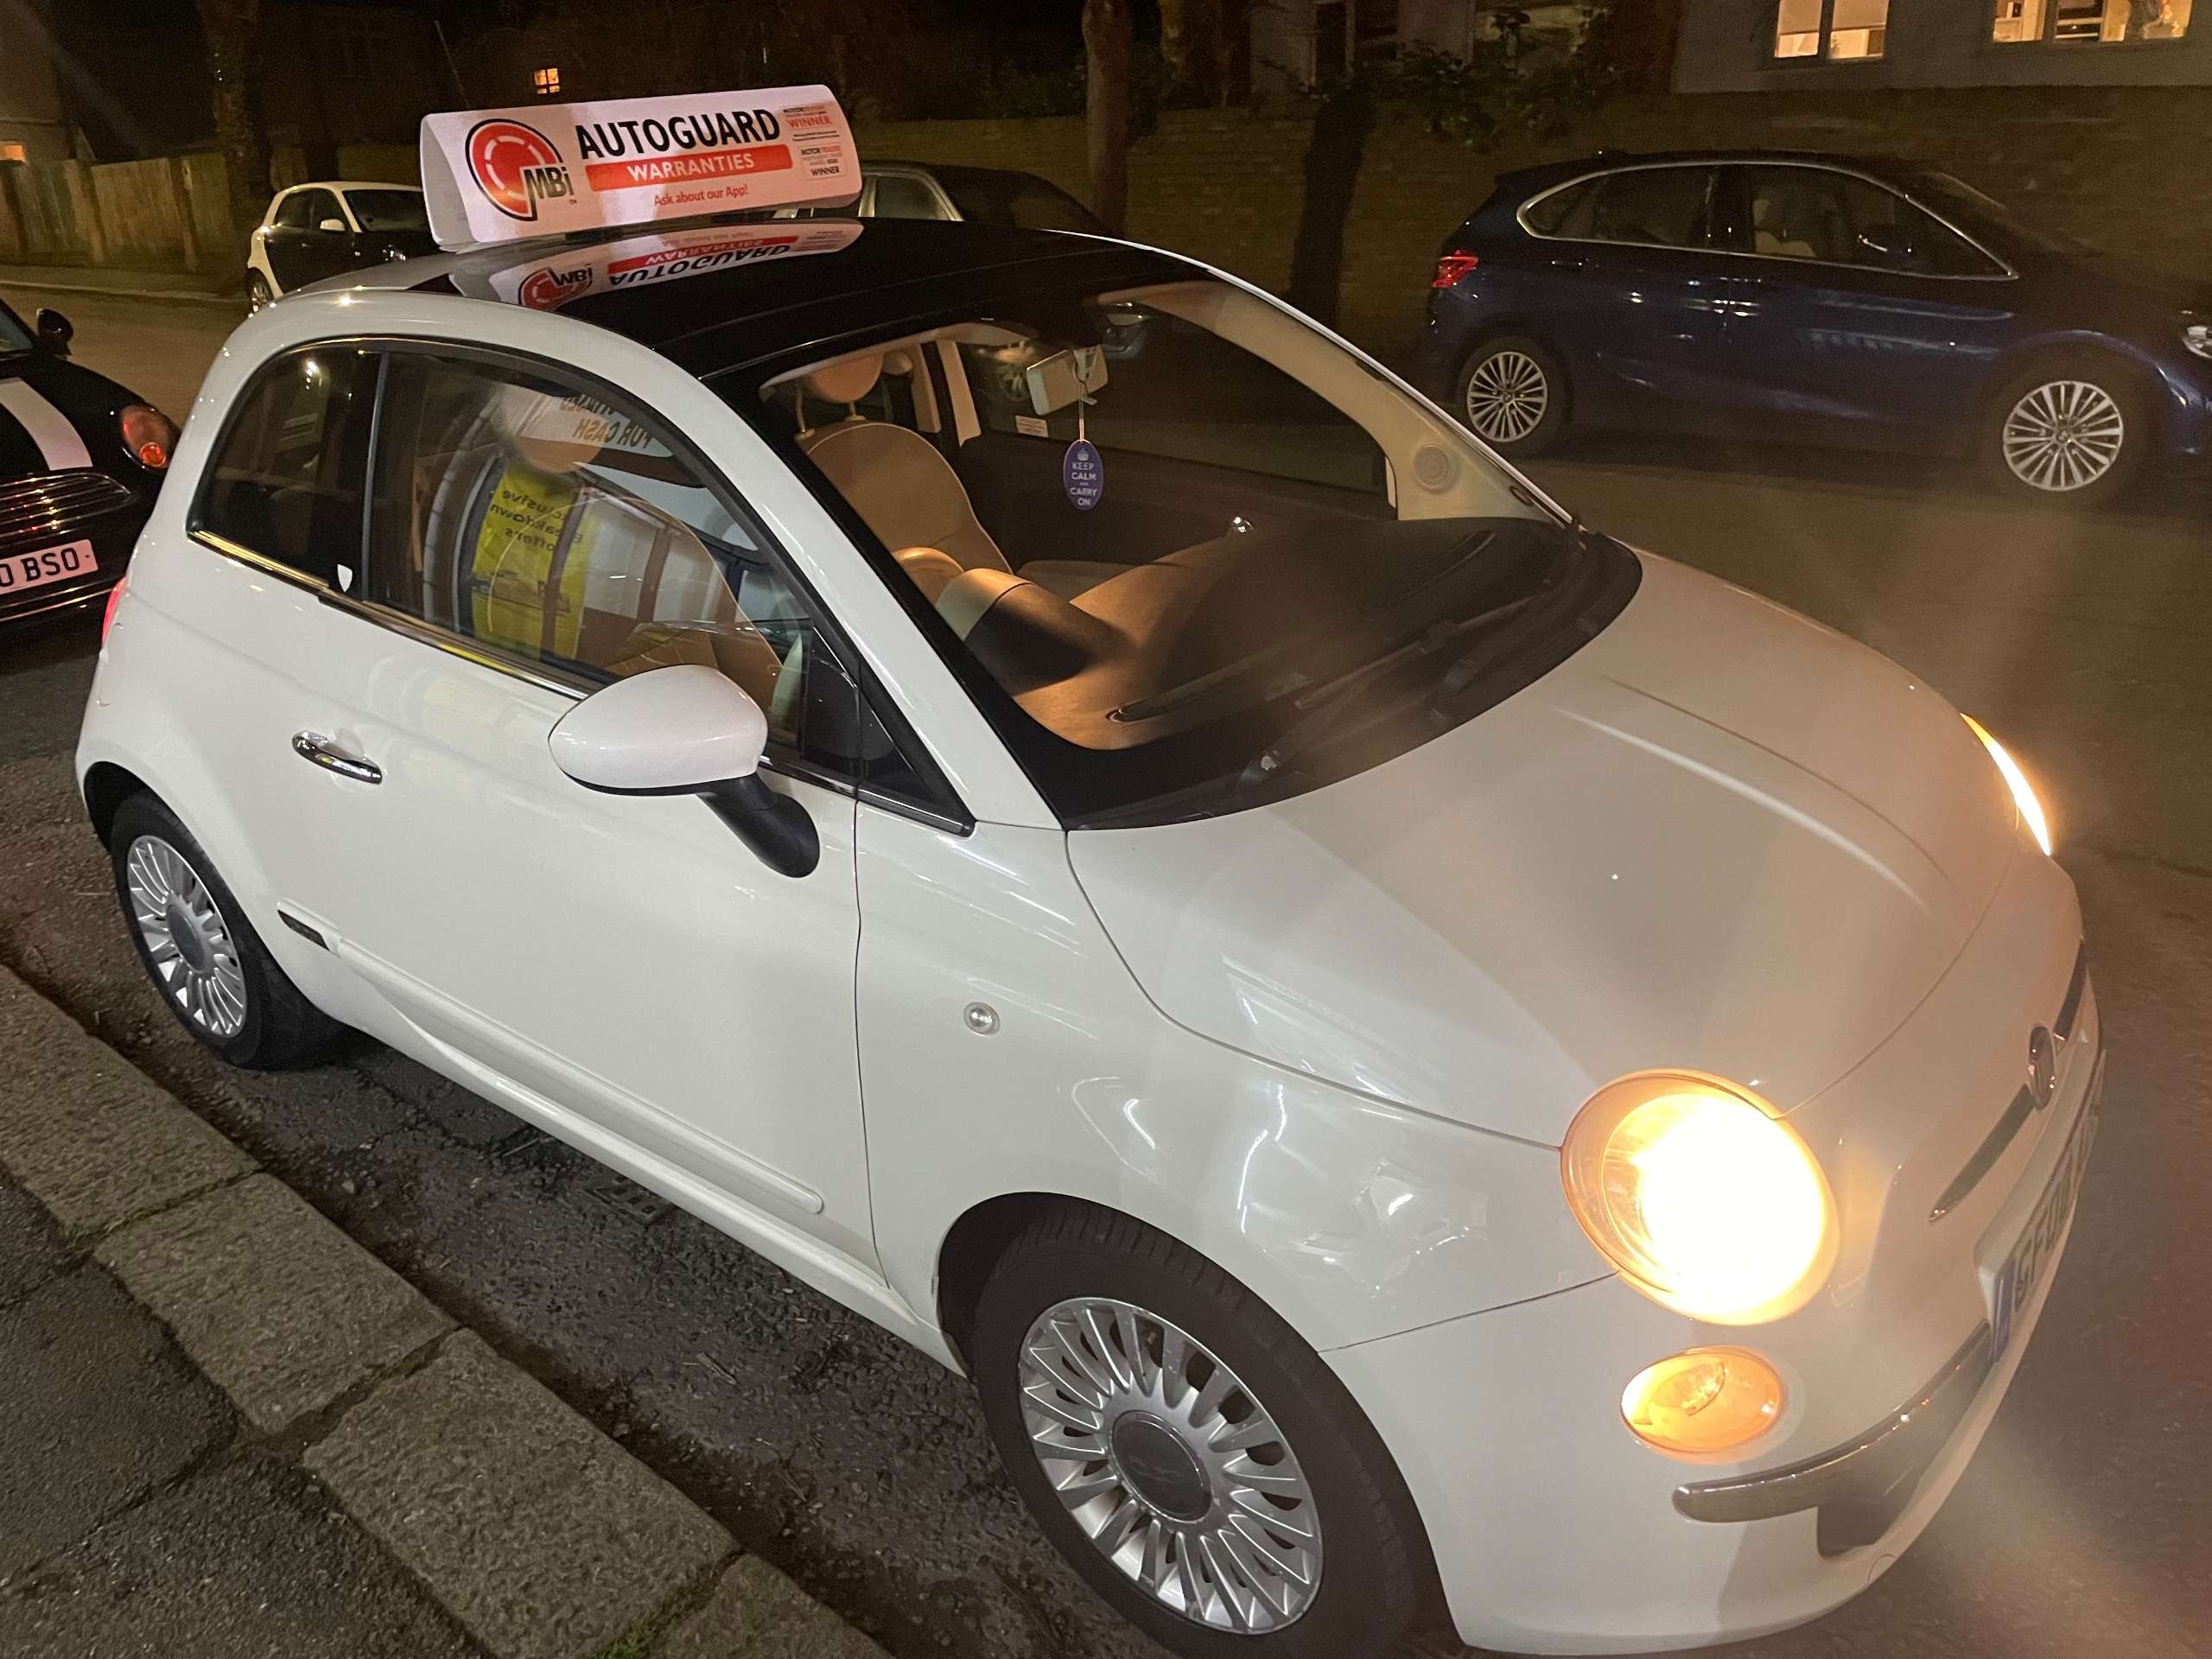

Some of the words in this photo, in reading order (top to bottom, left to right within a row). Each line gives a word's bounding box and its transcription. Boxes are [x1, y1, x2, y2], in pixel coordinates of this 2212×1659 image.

[787, 115, 831, 128] WINNER
[575, 109, 780, 160] AUTOGUARD
[626, 152, 755, 181] WARRANTIES
[810, 166, 840, 176] WINNER
[653, 194, 673, 207] Ask
[676, 191, 705, 203] about
[708, 189, 723, 199] our
[726, 184, 749, 199] App!
[1072, 461, 1095, 471] KEEP
[1071, 472, 1096, 480] CALM
[1070, 486, 1098, 496] CARRY
[1077, 498, 1091, 506] ON
